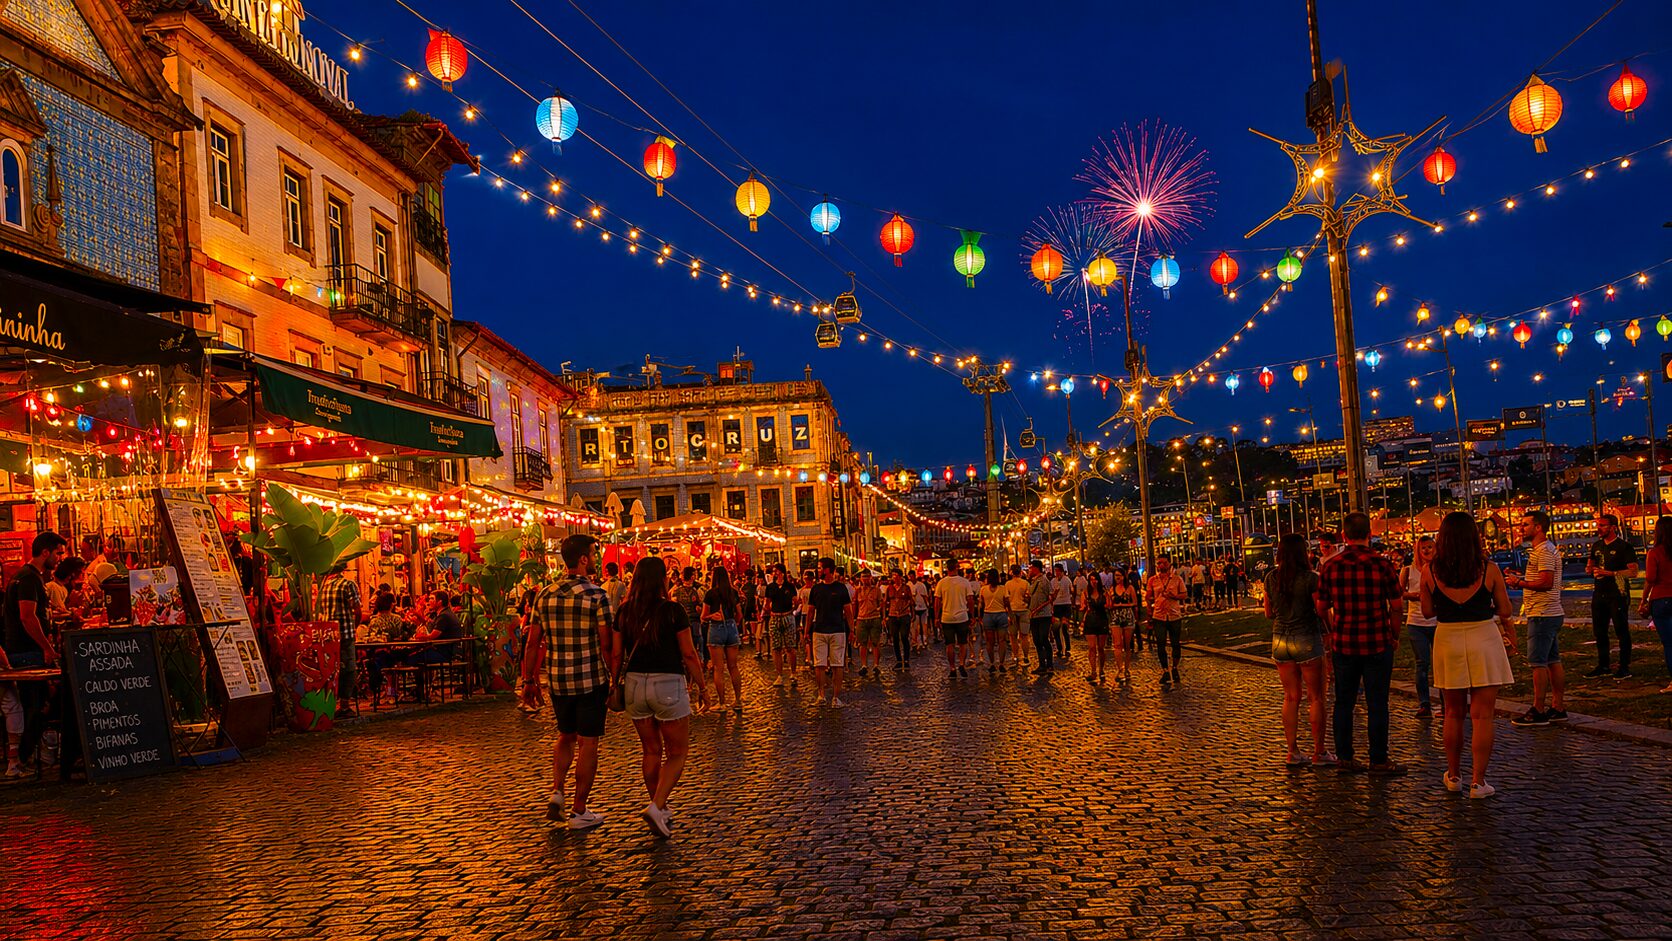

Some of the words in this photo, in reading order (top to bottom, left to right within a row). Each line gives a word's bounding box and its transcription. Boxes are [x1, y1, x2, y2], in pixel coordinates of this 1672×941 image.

[78, 639, 141, 657] SARDINHA
[89, 656, 134, 672] ASSADA
[85, 679, 118, 694] CALDO
[120, 675, 152, 690] VERDE
[89, 700, 119, 715] BROA
[92, 714, 142, 731] PIMENTOS
[95, 732, 139, 750] BIFANAS
[97, 754, 128, 770] VINHO
[130, 749, 160, 764] VERDE
